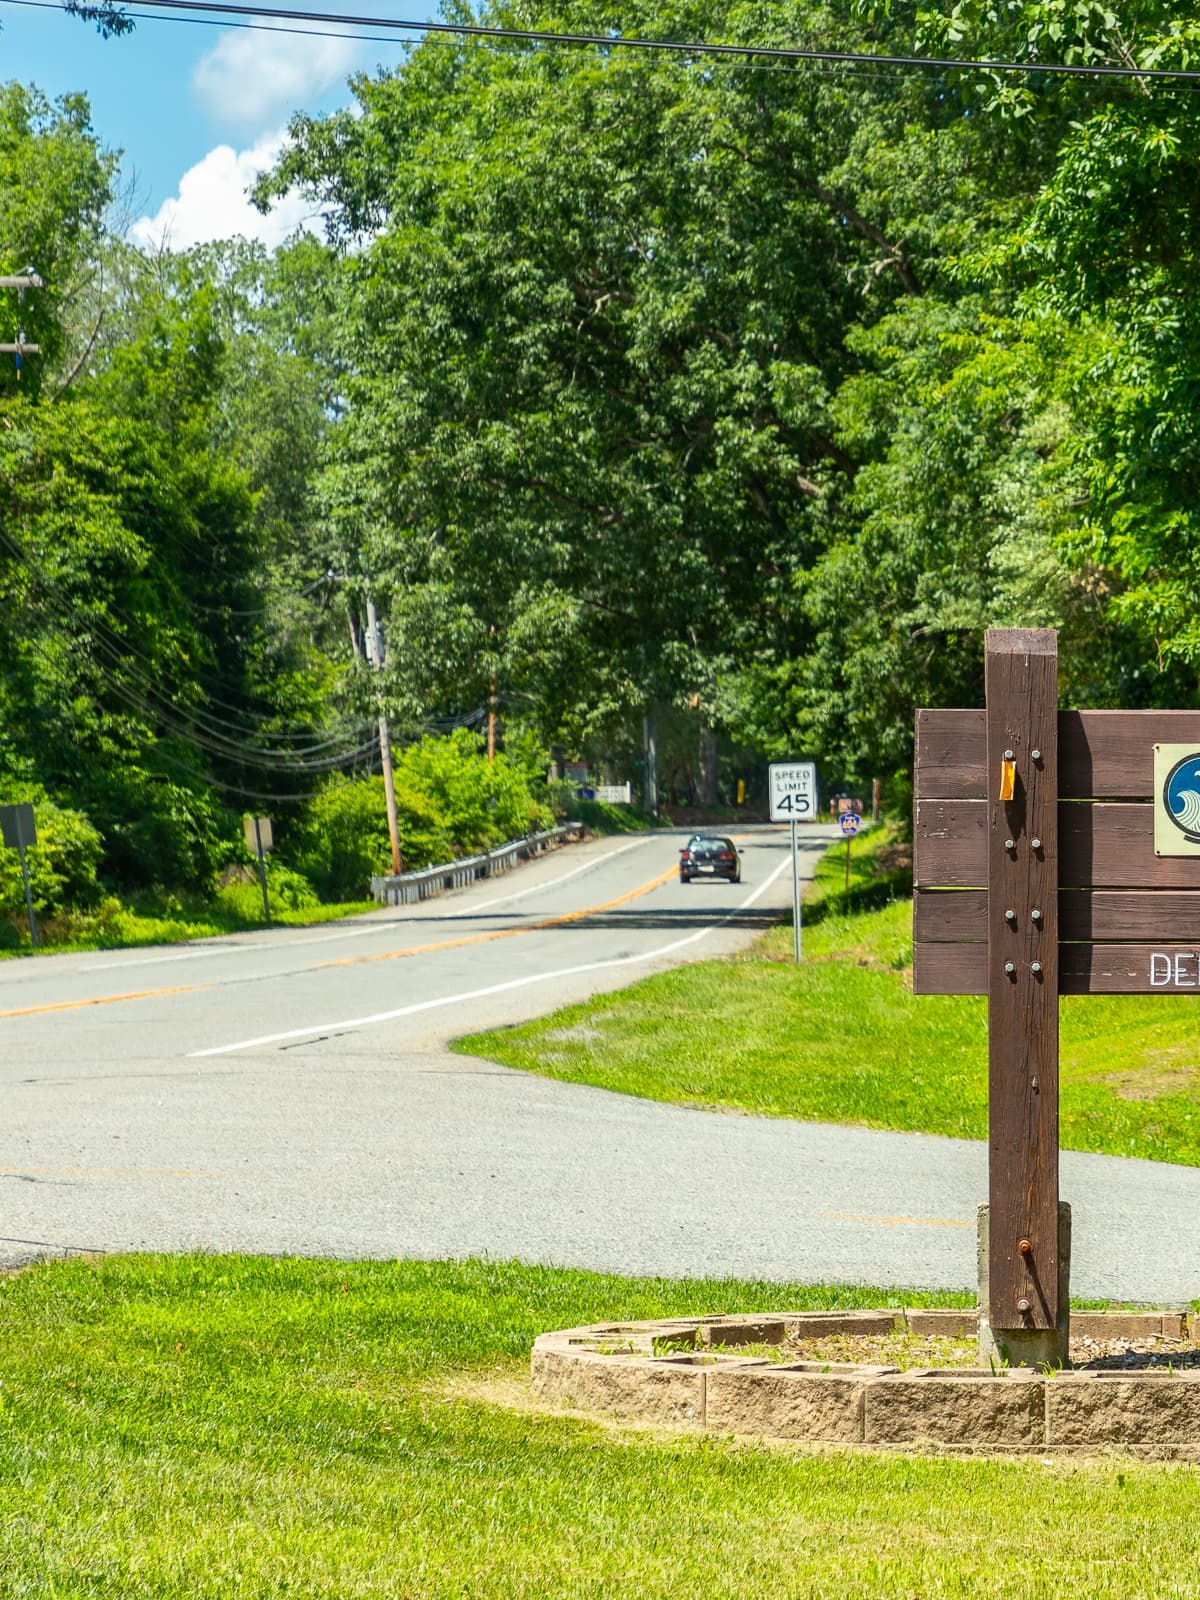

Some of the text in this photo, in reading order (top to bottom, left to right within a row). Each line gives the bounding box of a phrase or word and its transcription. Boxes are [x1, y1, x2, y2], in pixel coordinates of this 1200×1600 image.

[775, 770, 810, 780] SPEED
[777, 783, 807, 792] LIMIT
[776, 794, 810, 813] 45
